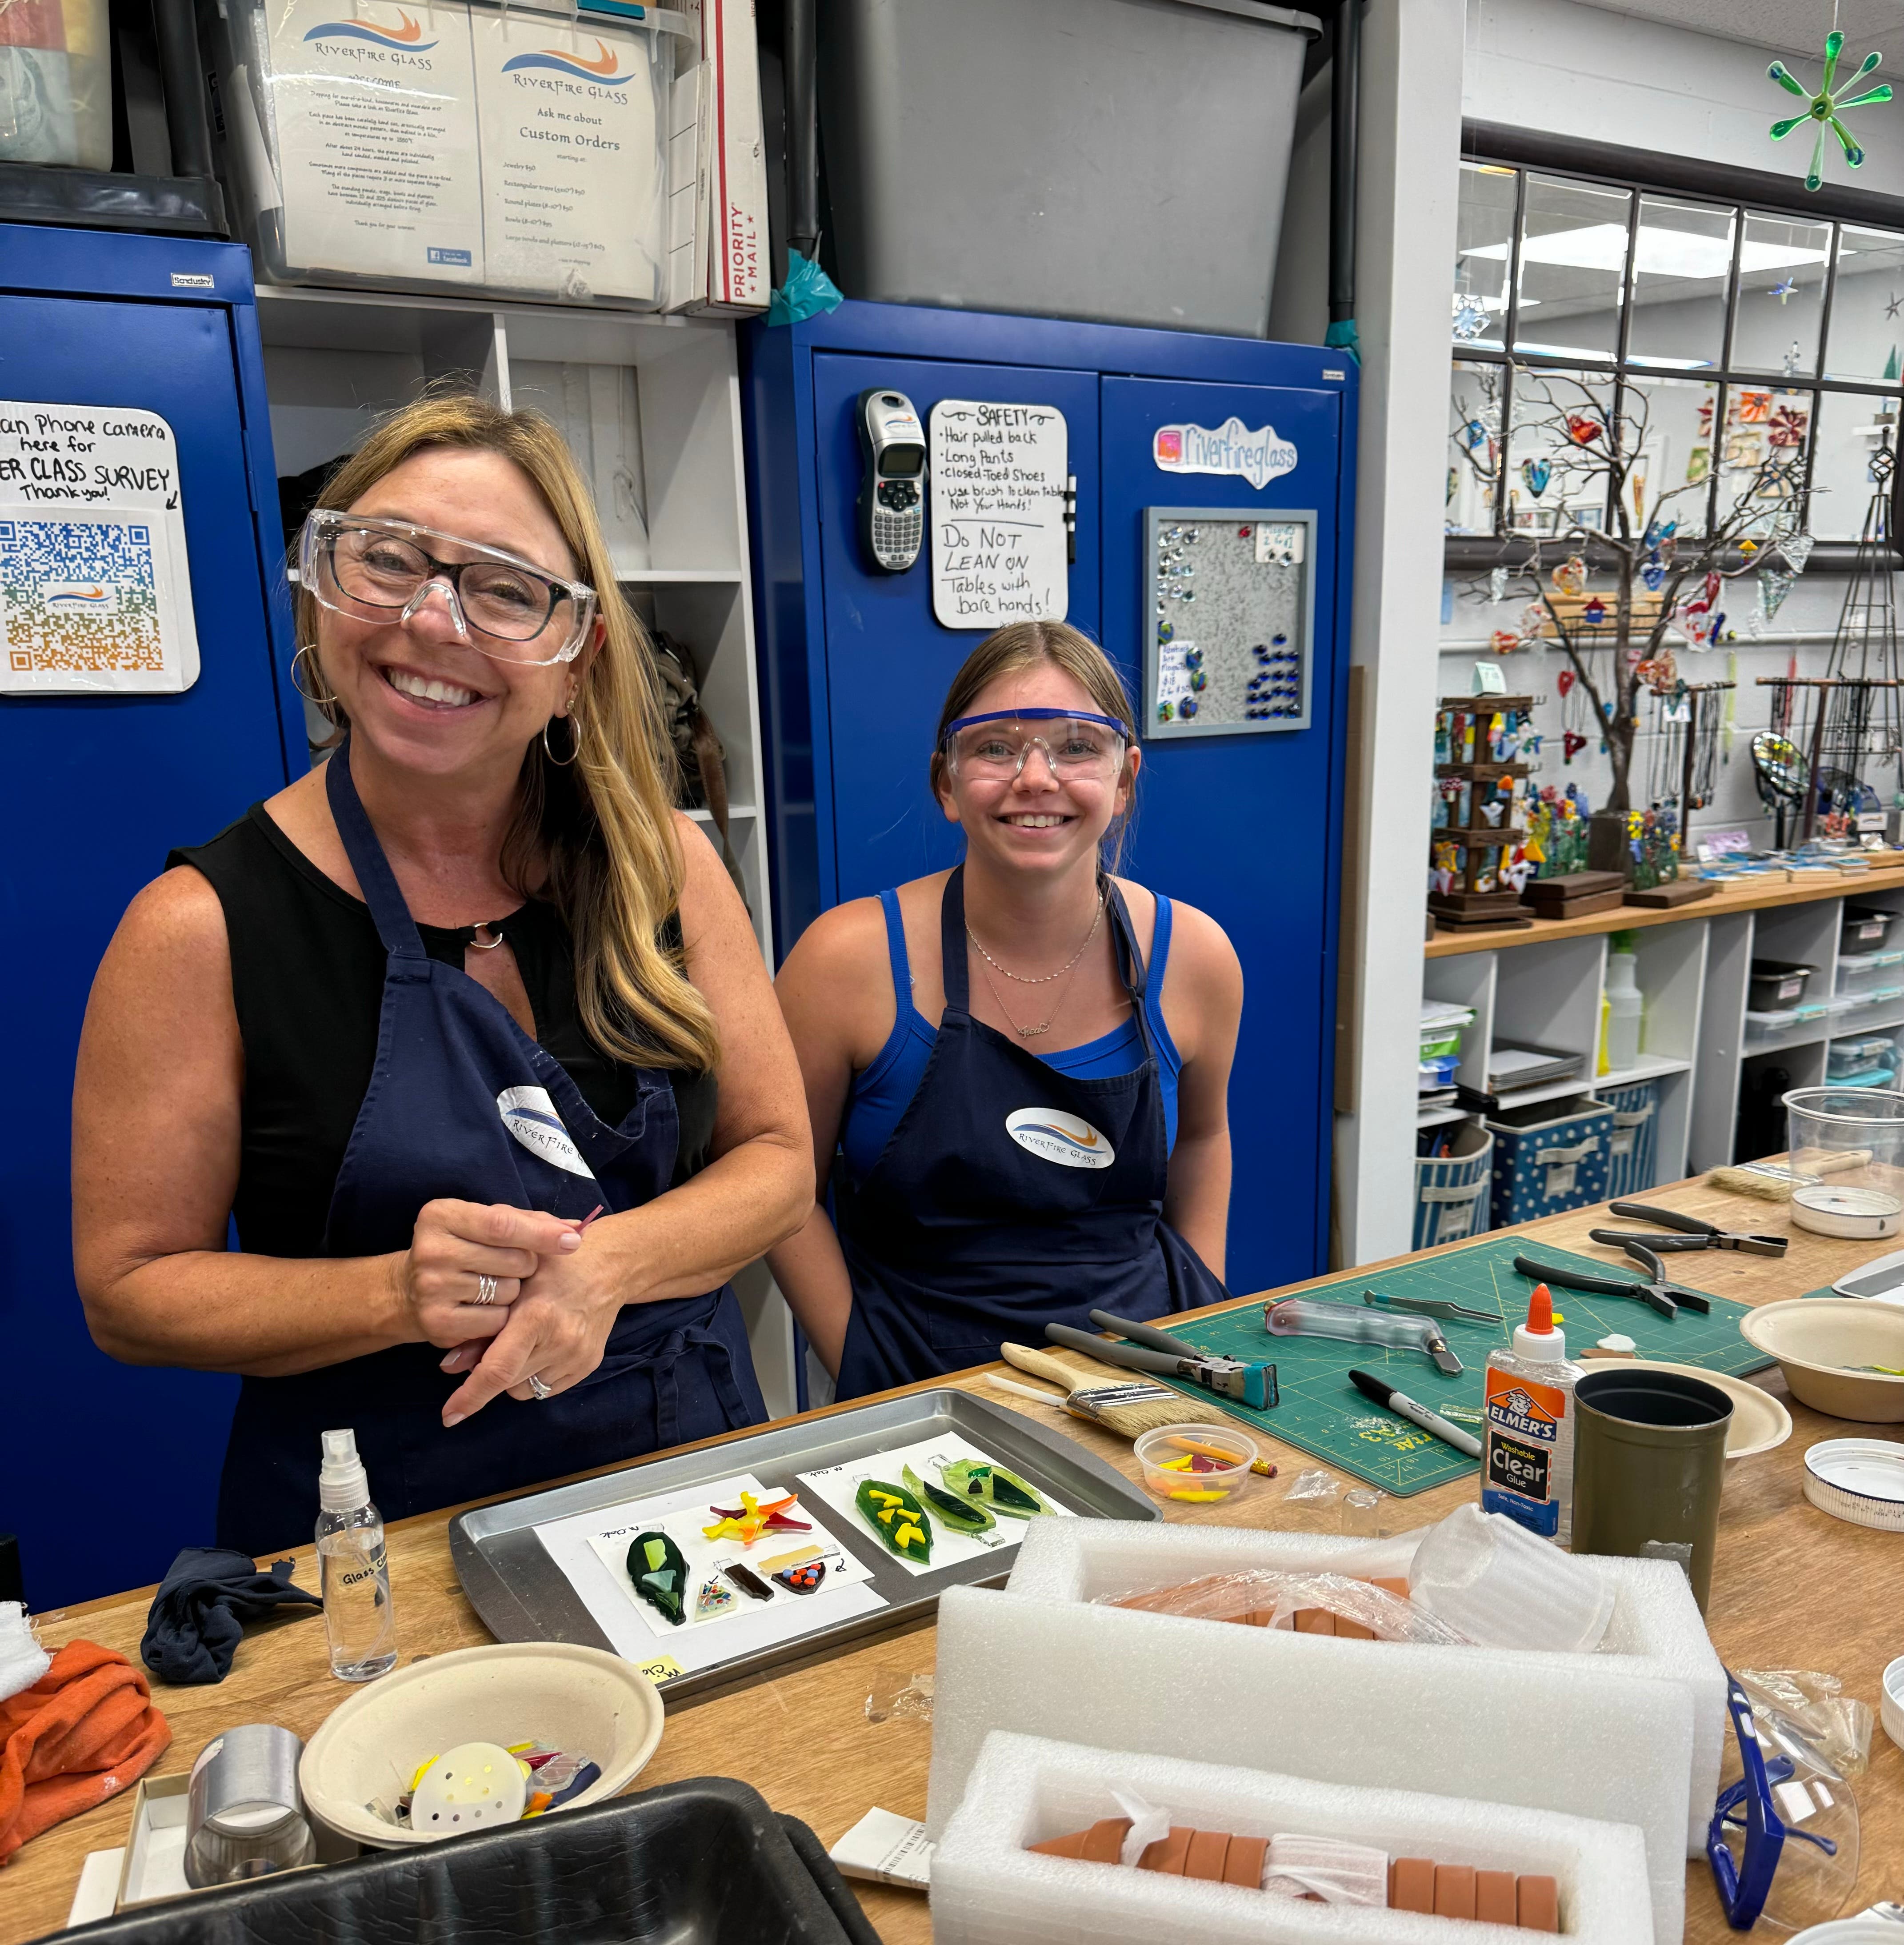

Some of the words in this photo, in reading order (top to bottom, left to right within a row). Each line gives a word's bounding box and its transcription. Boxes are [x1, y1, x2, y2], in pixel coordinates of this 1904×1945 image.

[391, 53, 432, 71] GLASS
[588, 86, 628, 105] GLASS
[537, 107, 555, 118] Ask
[557, 112, 571, 120] me
[574, 112, 602, 125] about
[520, 127, 571, 144] Custom
[575, 135, 620, 150] Orders
[503, 162, 524, 170] Jewelry
[731, 204, 746, 297] PRIORITY
[746, 231, 757, 278] MAIL
[0, 418, 30, 435] an
[35, 414, 96, 435] Phone
[976, 404, 1028, 427] SAFETY
[20, 437, 60, 452] here
[67, 435, 96, 452] for
[944, 425, 968, 444] Hair
[973, 429, 1003, 447] pulled
[1008, 430, 1038, 445] back
[945, 447, 977, 468] Long
[980, 449, 1015, 466] Pants
[1185, 420, 1296, 487] riverfireglass
[31, 457, 87, 483] CLASS
[94, 465, 170, 492] SURVEY
[1012, 468, 1046, 482] Shoes
[20, 483, 80, 501] Thank
[81, 486, 111, 502] you!
[972, 484, 1004, 497] brush
[949, 497, 970, 511] Not
[972, 496, 994, 514] Your
[980, 526, 1023, 549] NOT
[945, 551, 1000, 572] LEAN
[1005, 555, 1030, 571] ON
[940, 574, 997, 595] Tables
[1001, 572, 1031, 592] with
[956, 595, 996, 615] bare
[998, 587, 1051, 615] hands!
[1070, 1150, 1096, 1166] GLASS
[1491, 1405, 1553, 1438] ELMER'S
[1501, 1441, 1536, 1461] Washable
[1492, 1448, 1545, 1482] Clear
[1506, 1473, 1526, 1488] Glue
[1498, 1493, 1509, 1502] Safe,
[343, 1565, 374, 1585] Glass
